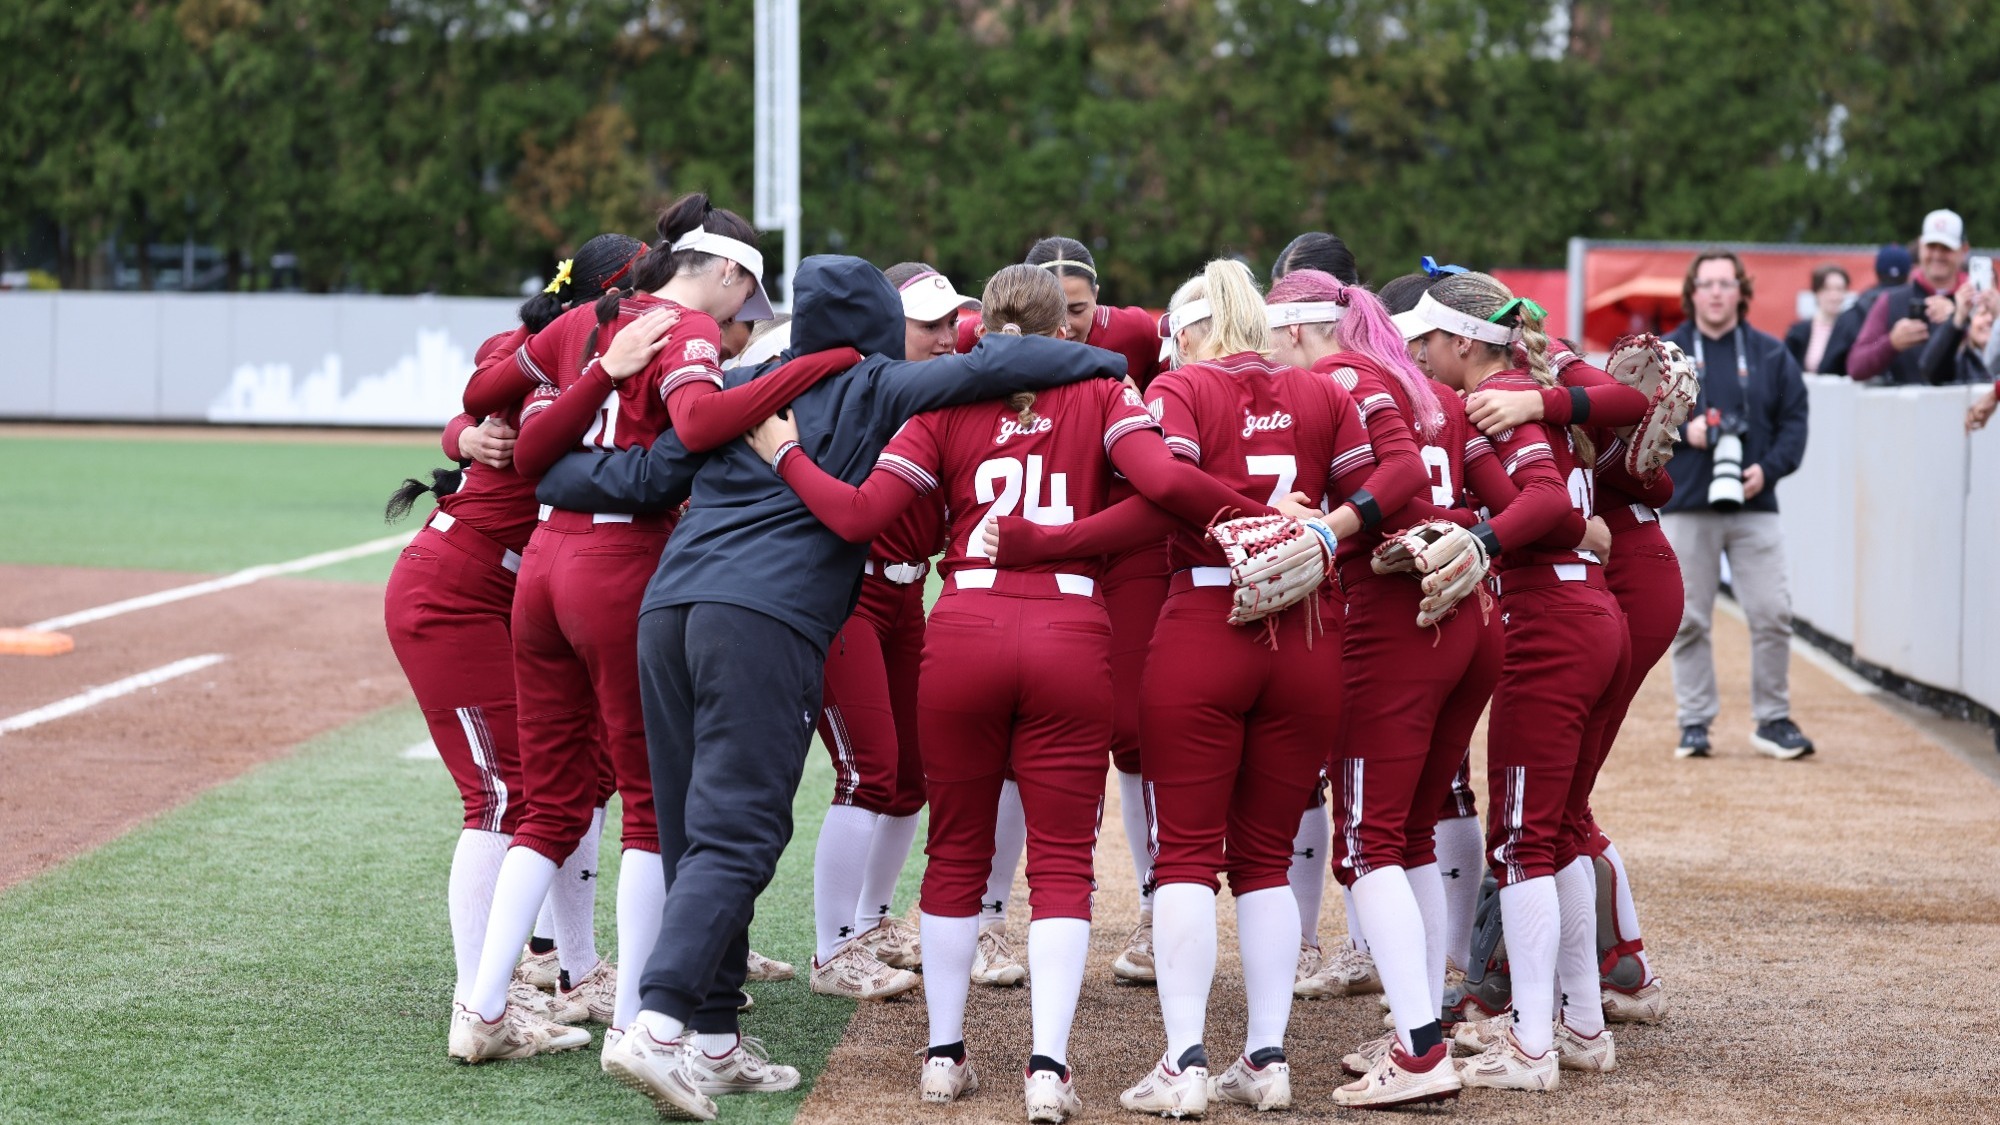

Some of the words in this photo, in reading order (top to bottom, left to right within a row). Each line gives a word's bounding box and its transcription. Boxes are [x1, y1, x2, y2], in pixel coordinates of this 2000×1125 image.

[934, 278, 946, 290] C
[1242, 409, 1293, 438] 'gate
[1245, 454, 1298, 506] 7
[965, 454, 1075, 558] 24
